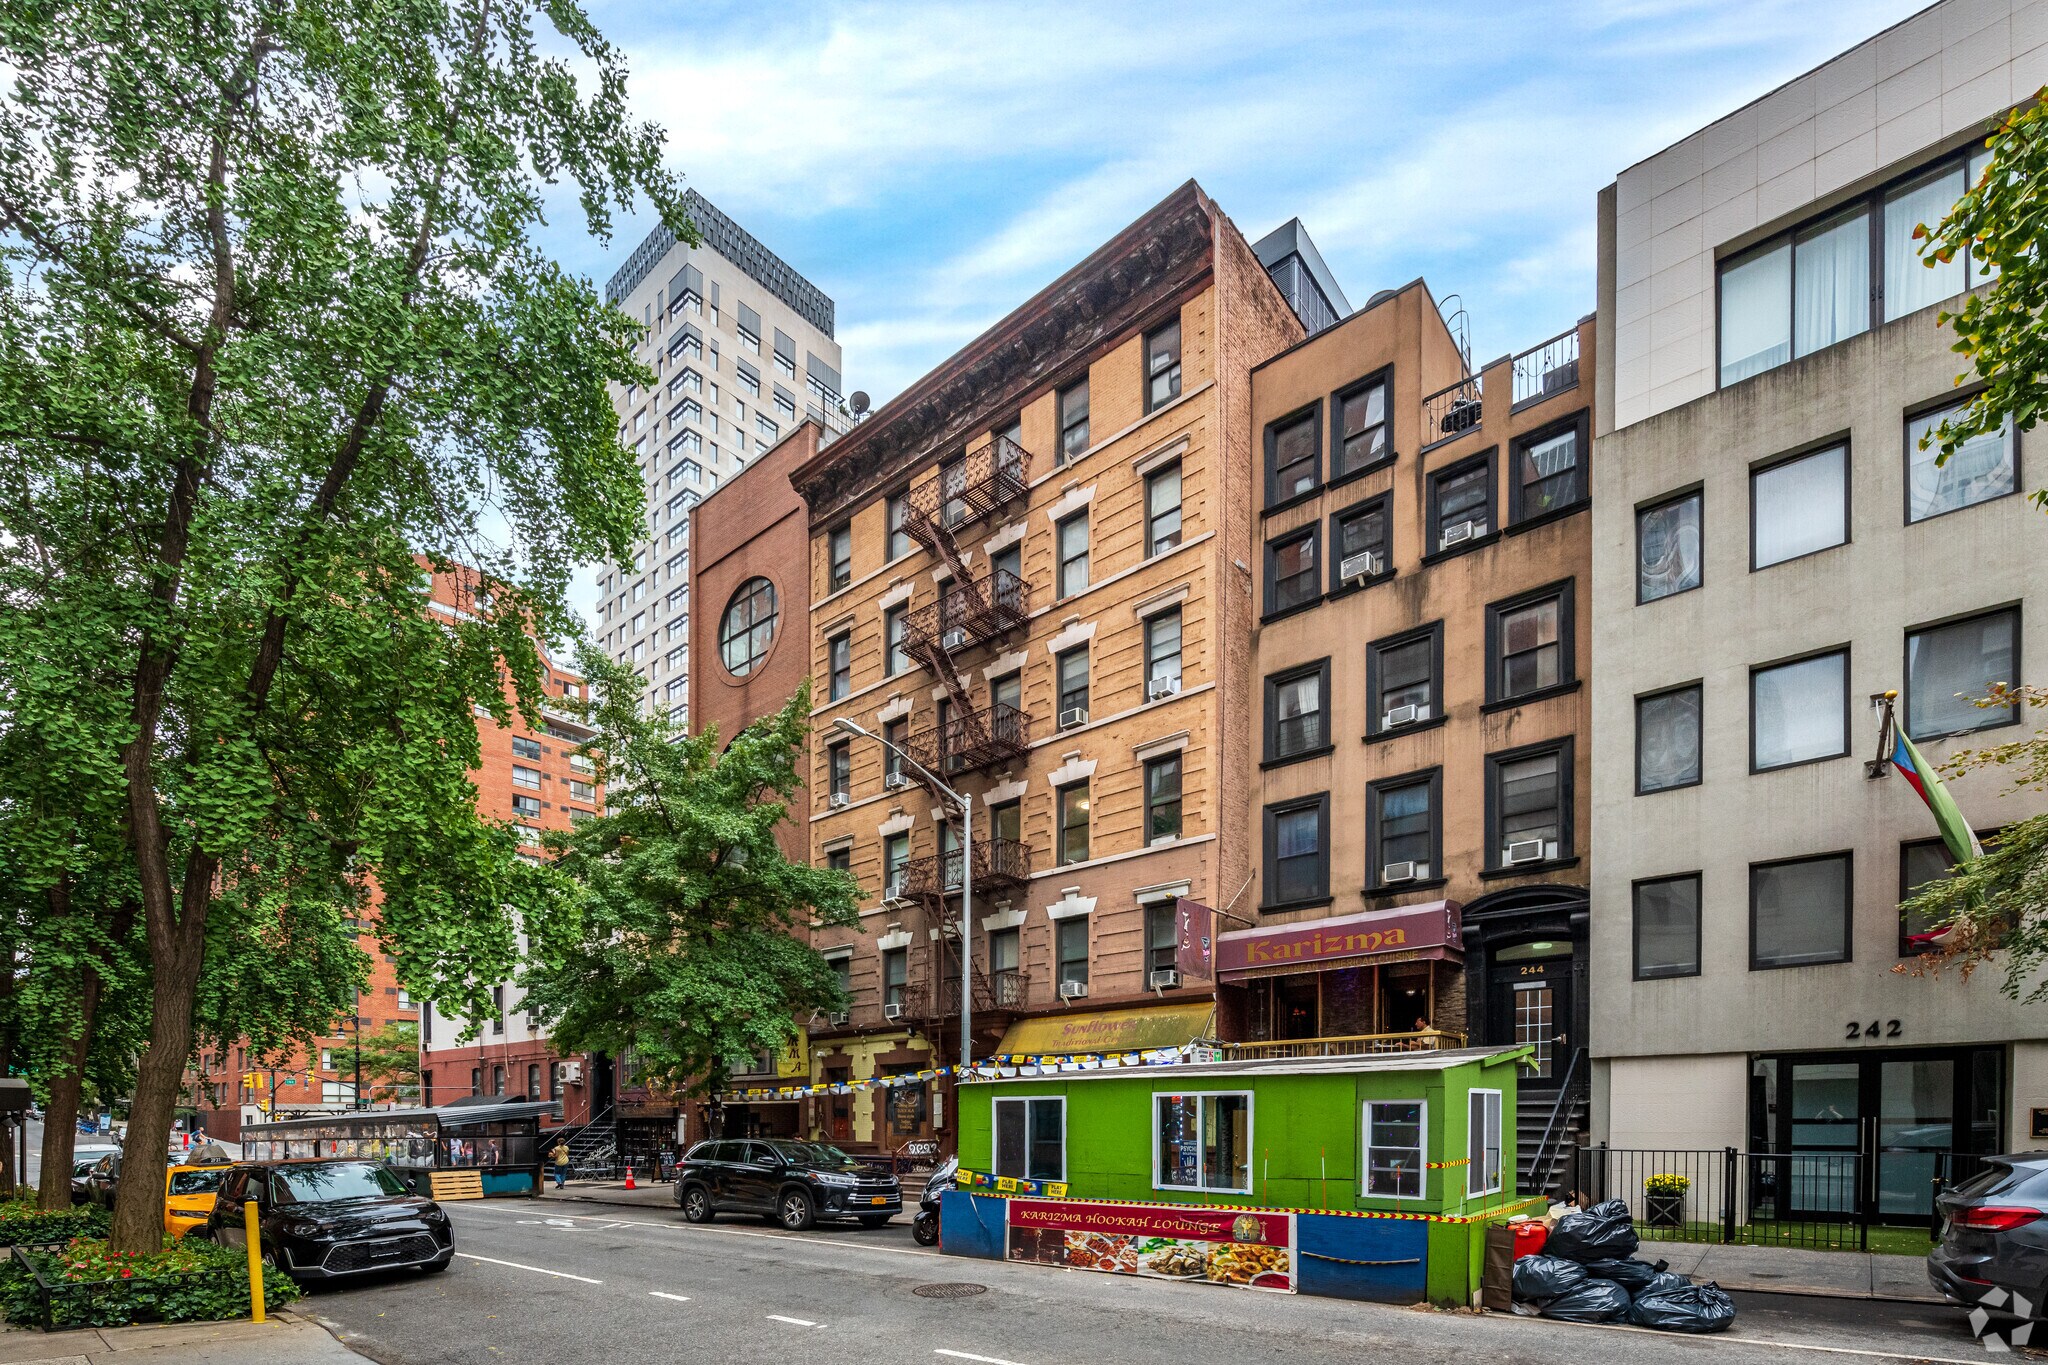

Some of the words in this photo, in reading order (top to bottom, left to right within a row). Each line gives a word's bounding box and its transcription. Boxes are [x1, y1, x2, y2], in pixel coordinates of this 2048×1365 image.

[1247, 927, 1406, 962] Karizma
[1327, 956, 1376, 969] AMERICAN
[1380, 951, 1418, 964] CUISINE
[1520, 965, 1545, 975] 244
[1846, 1019, 1903, 1040] 242
[1020, 1210, 1083, 1223] KARIZMA
[1085, 1213, 1151, 1228] HOOKAH
[1152, 1219, 1222, 1235] LOUNGE
